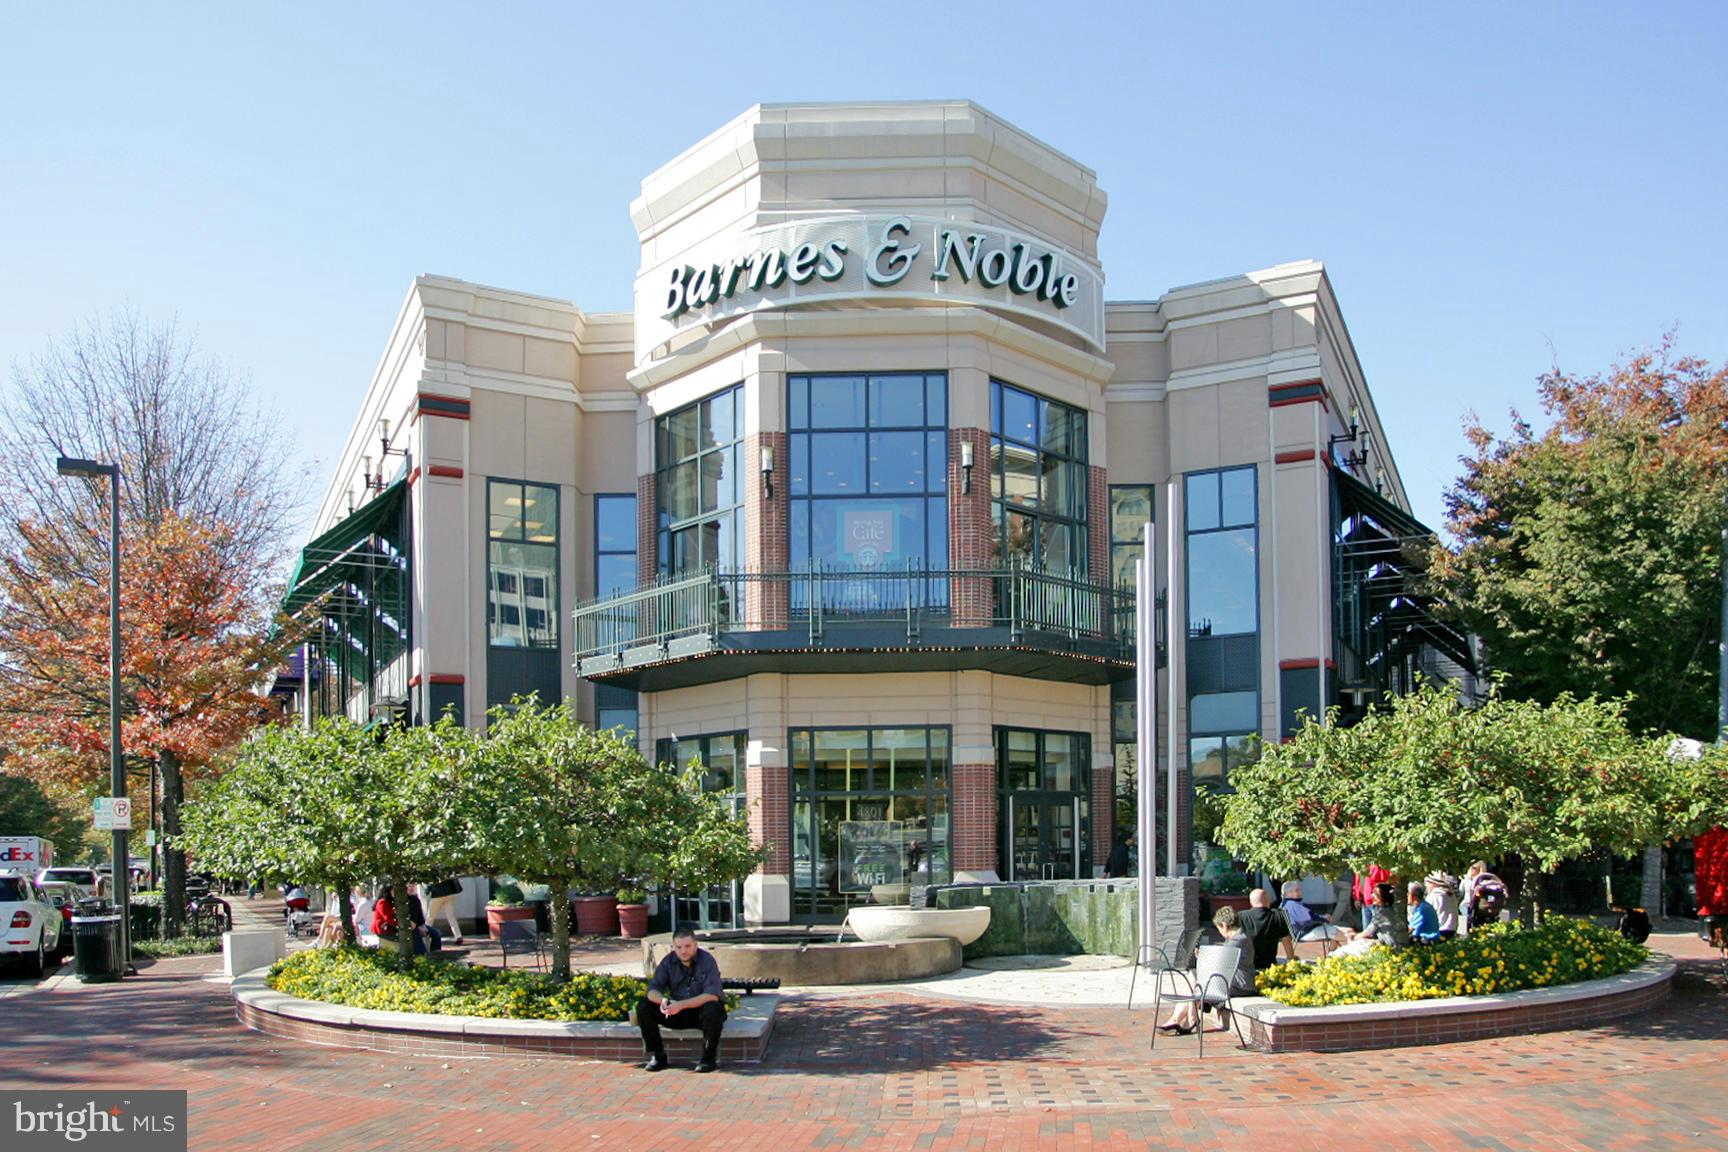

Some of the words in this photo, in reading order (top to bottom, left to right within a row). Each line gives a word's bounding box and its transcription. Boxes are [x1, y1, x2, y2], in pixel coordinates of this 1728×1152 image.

[661, 240, 848, 321] Barnes
[865, 216, 921, 287] &
[930, 229, 1079, 309] Noble
[857, 807, 882, 817] 4801
[0, 848, 33, 861] dEx
[856, 864, 886, 872] FREE
